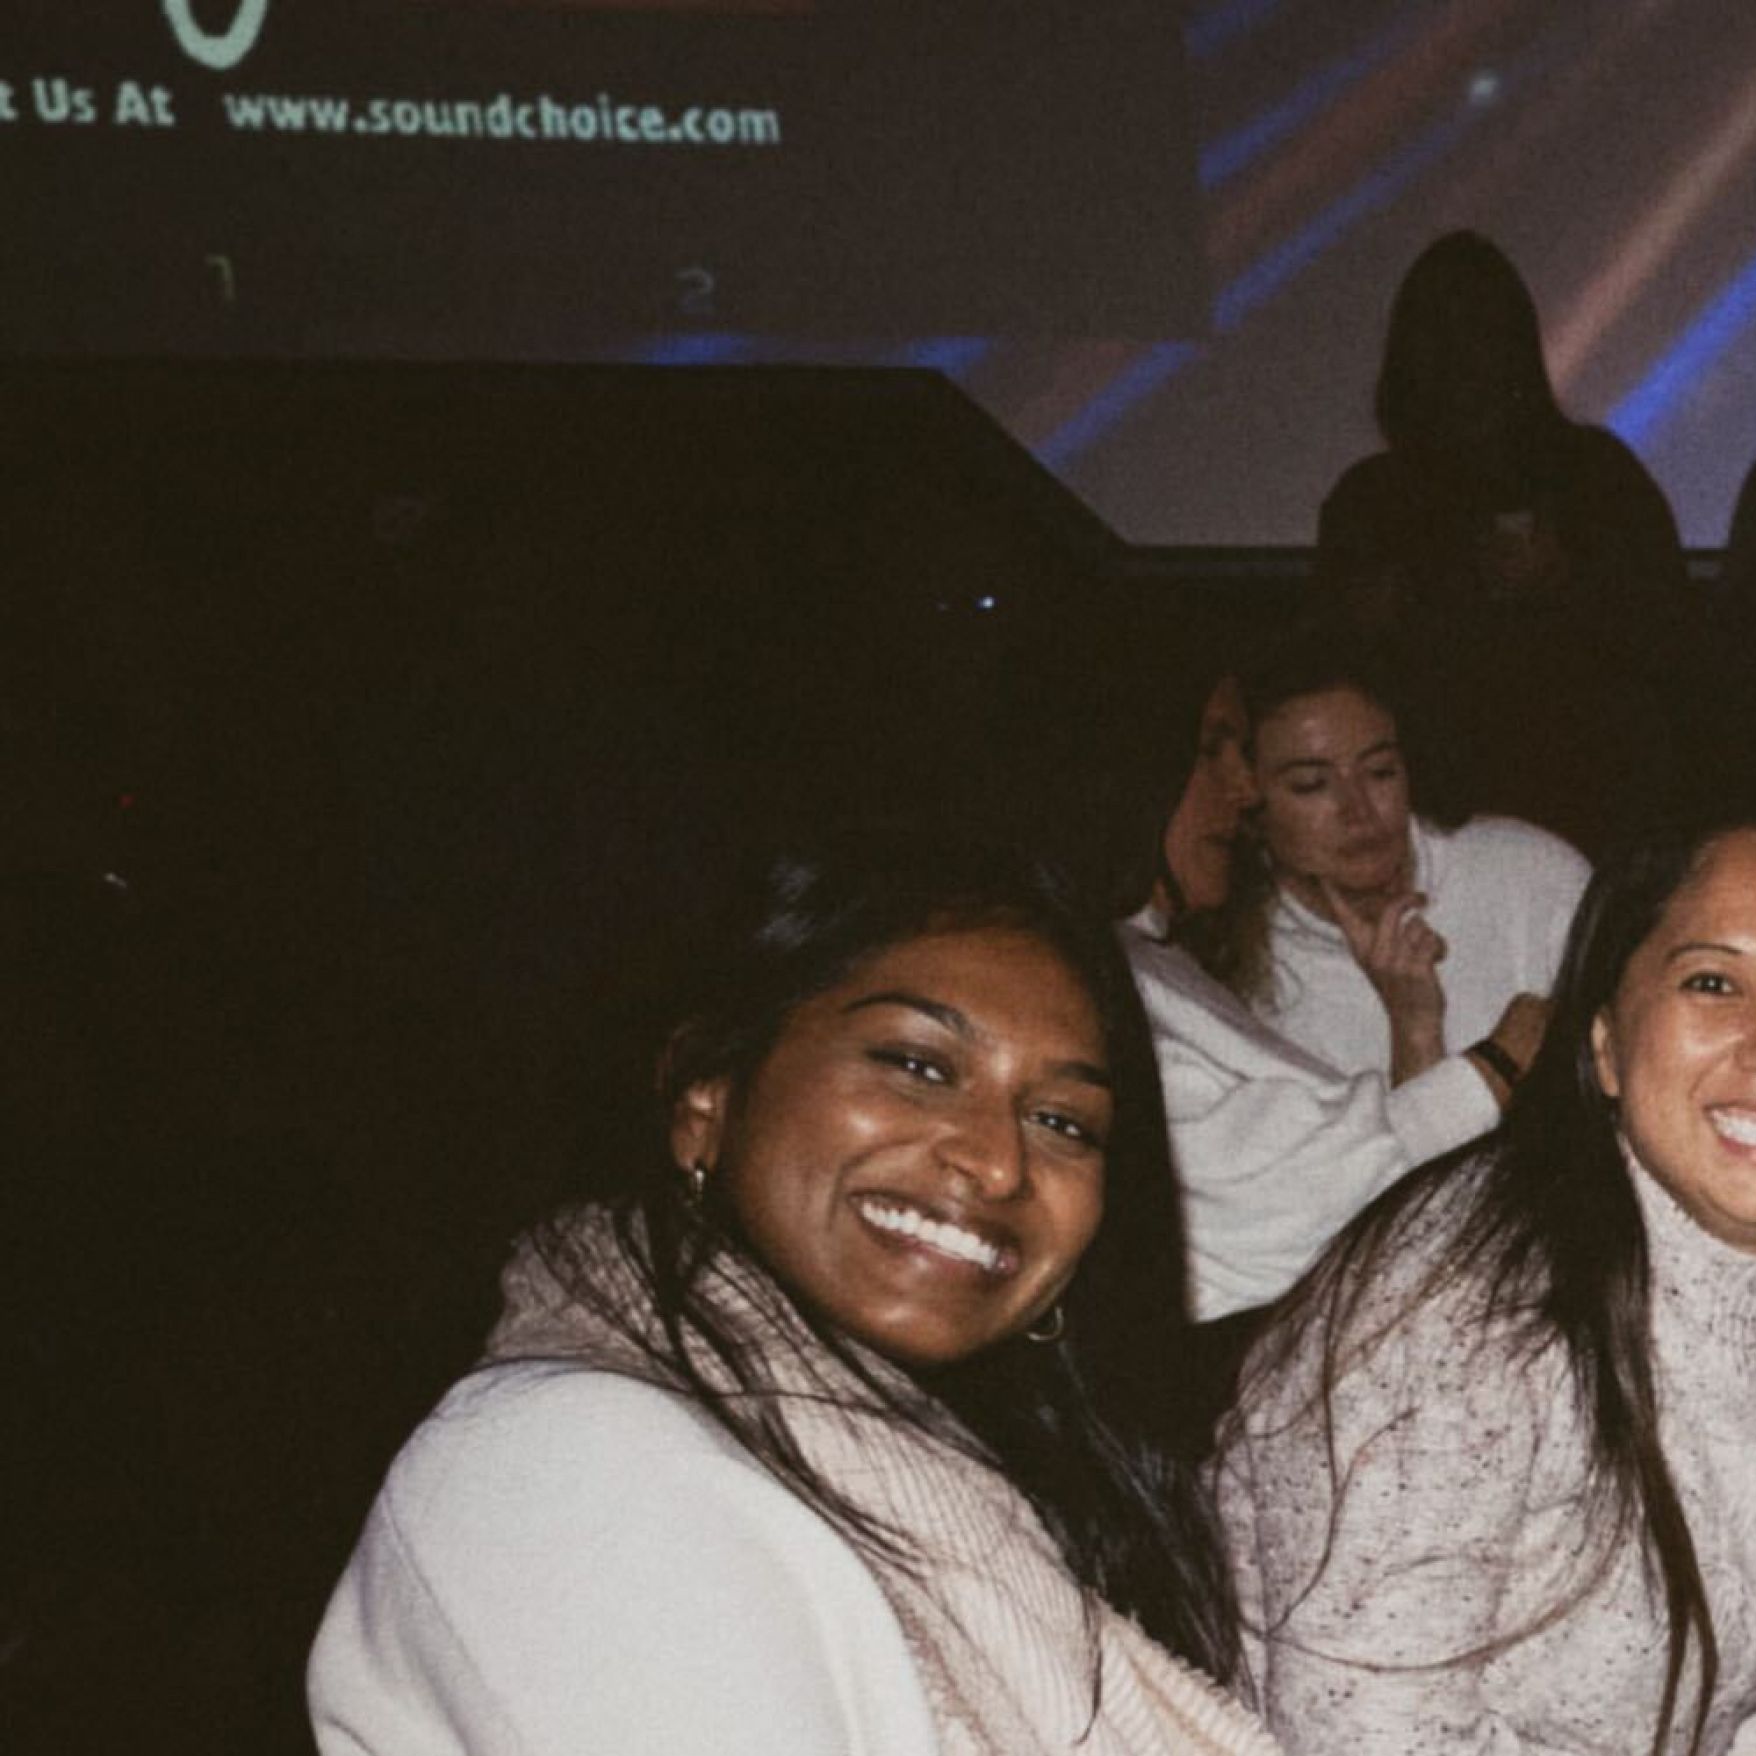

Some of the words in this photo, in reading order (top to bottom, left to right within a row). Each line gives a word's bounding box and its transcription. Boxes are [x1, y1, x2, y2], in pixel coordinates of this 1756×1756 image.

[33, 78, 96, 123] Us
[116, 80, 176, 127] At
[222, 92, 780, 144] www.soundchoice.com
